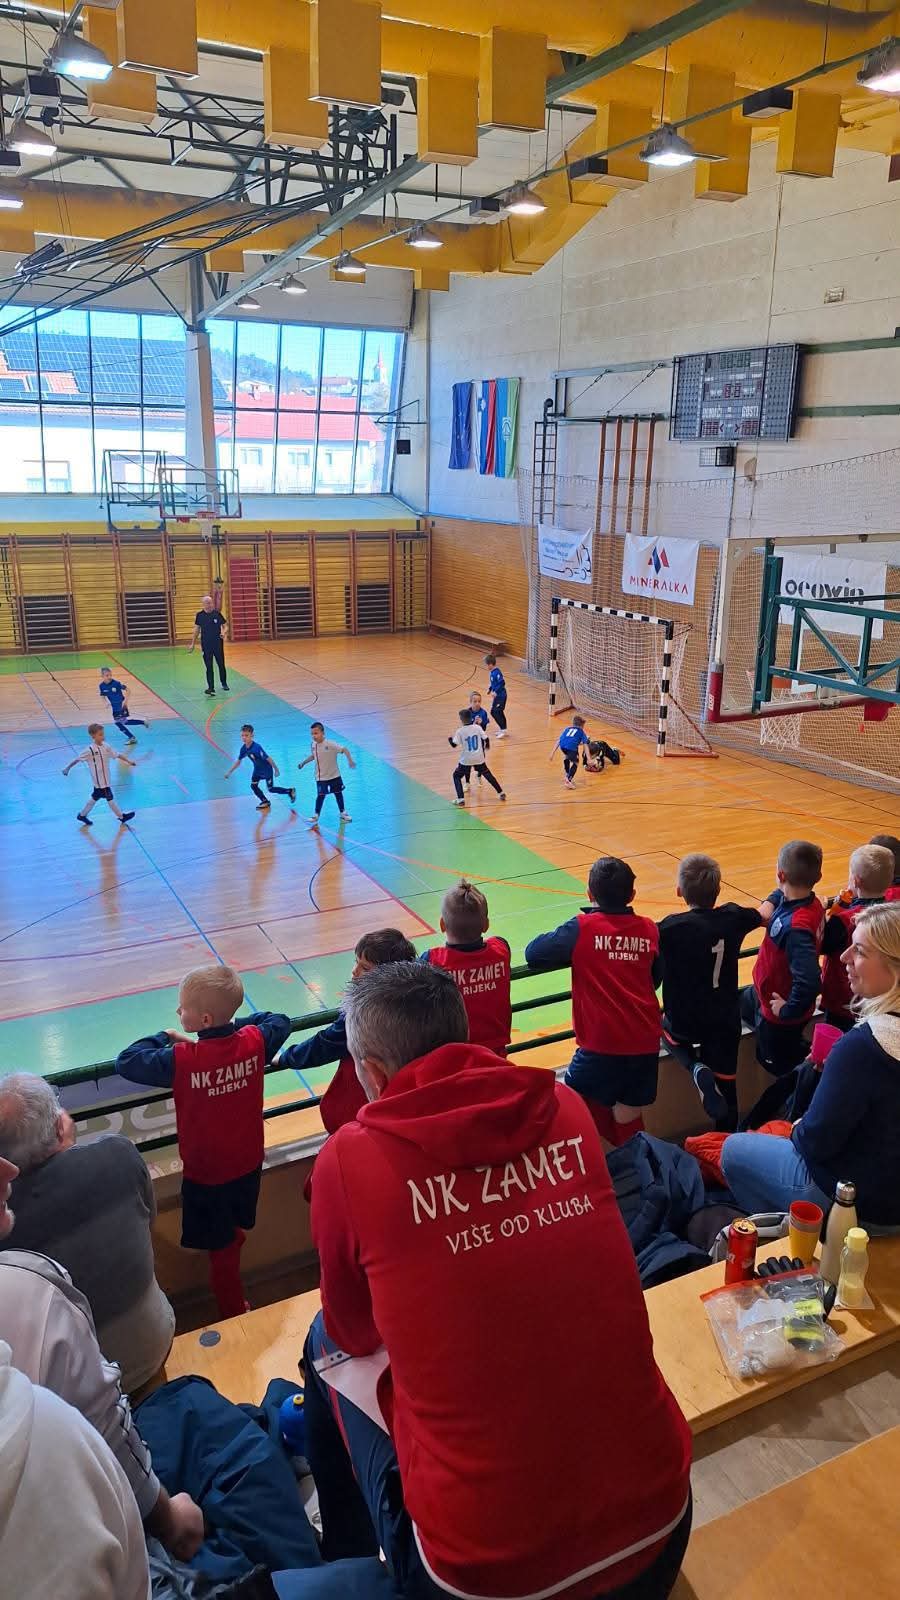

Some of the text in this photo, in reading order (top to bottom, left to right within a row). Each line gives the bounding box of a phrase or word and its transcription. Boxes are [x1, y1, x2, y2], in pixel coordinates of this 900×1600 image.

[741, 405, 759, 418] GOSTI
[629, 575, 689, 595] MINERALKA
[567, 728, 577, 737] 11
[465, 735, 479, 751] 10
[594, 935, 650, 952] NK ZAMET
[608, 951, 639, 961] RIJEKA
[711, 939, 725, 989] 1
[470, 961, 506, 983] ZAMET
[463, 981, 497, 995] RIJEKA
[191, 1055, 259, 1089] NK ZAMET
[208, 1079, 248, 1097] RIJEKA
[407, 1134, 587, 1225] NK ZAMET
[446, 1194, 595, 1255] VIŠE OD KLUBA
